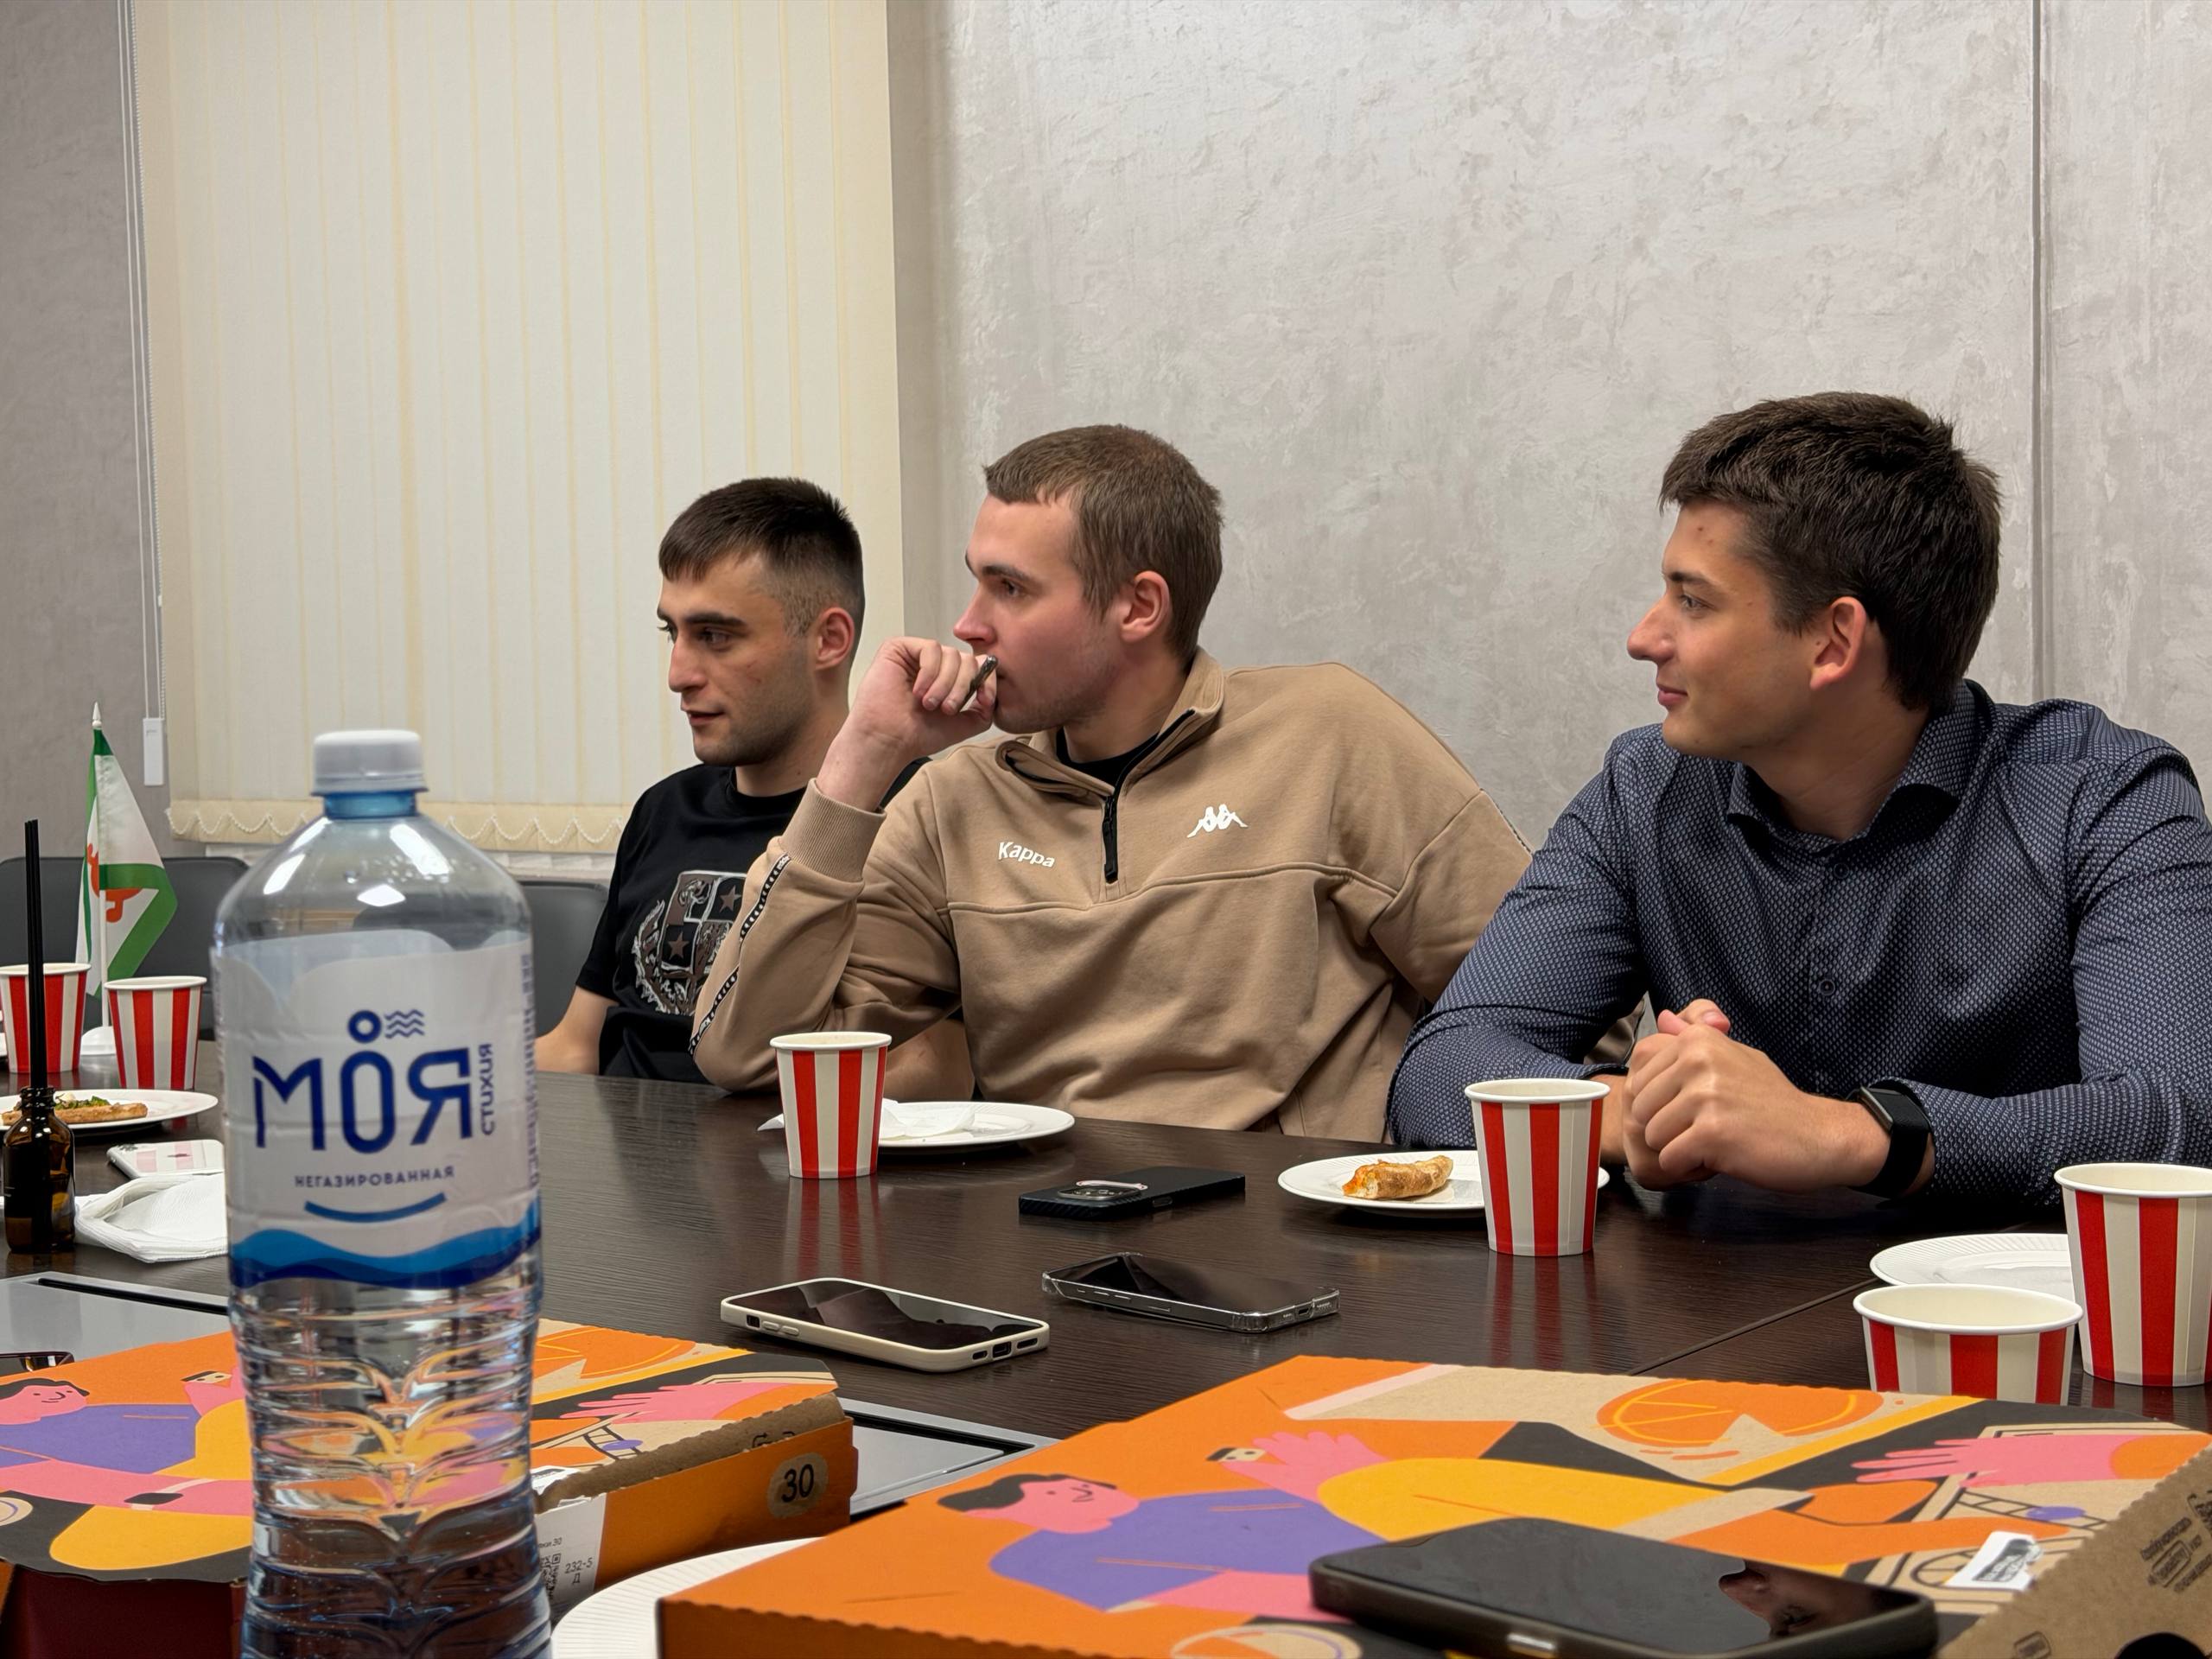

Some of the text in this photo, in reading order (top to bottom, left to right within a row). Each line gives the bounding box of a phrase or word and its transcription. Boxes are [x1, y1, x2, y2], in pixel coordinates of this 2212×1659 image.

[998, 842, 1055, 868] Kappa
[251, 1047, 473, 1154] МОЯ
[294, 1166, 455, 1189] НЕГАЗИРОВАННАЯ
[780, 1463, 815, 1503] 30
[564, 1556, 594, 1574] 232-5
